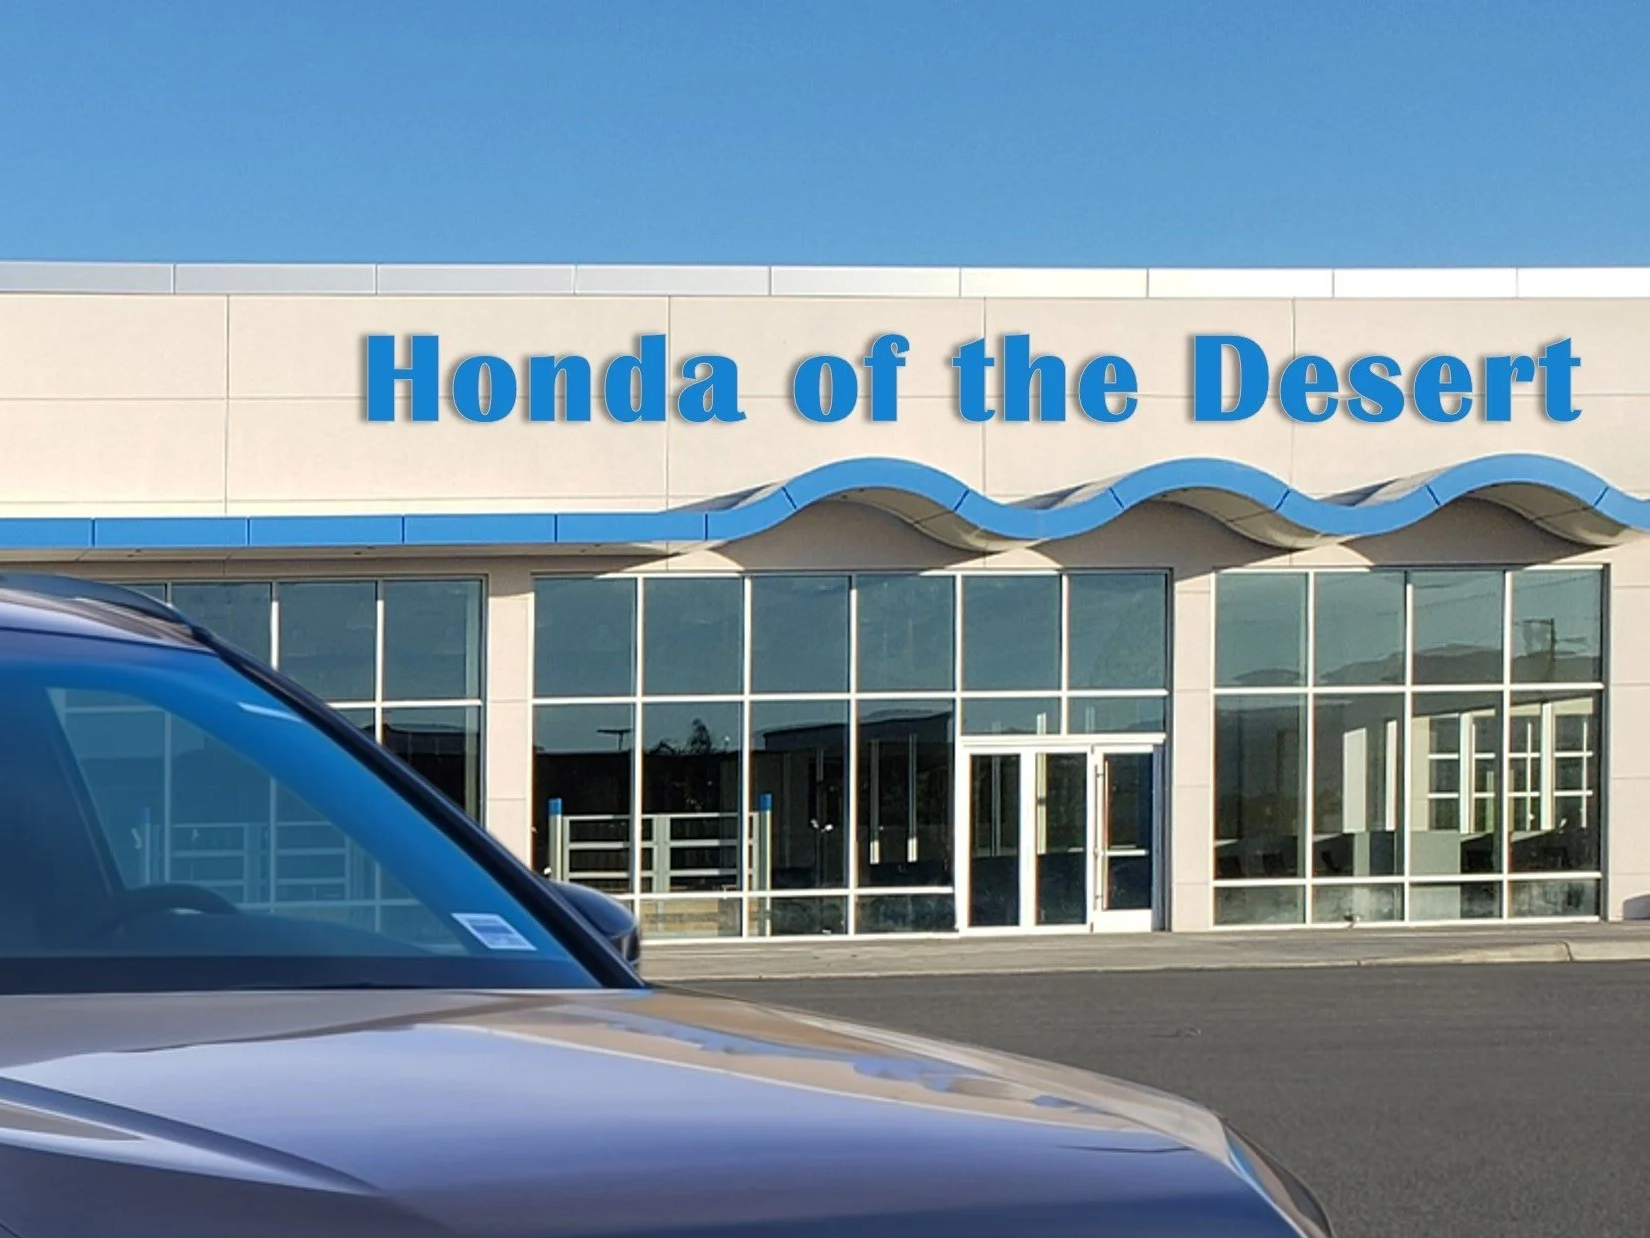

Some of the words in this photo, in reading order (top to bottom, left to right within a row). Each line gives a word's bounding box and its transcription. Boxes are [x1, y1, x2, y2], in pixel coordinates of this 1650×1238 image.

[366, 333, 747, 423] Honda
[792, 333, 910, 423] of
[951, 333, 1139, 423] the
[1193, 334, 1583, 423] Desert
